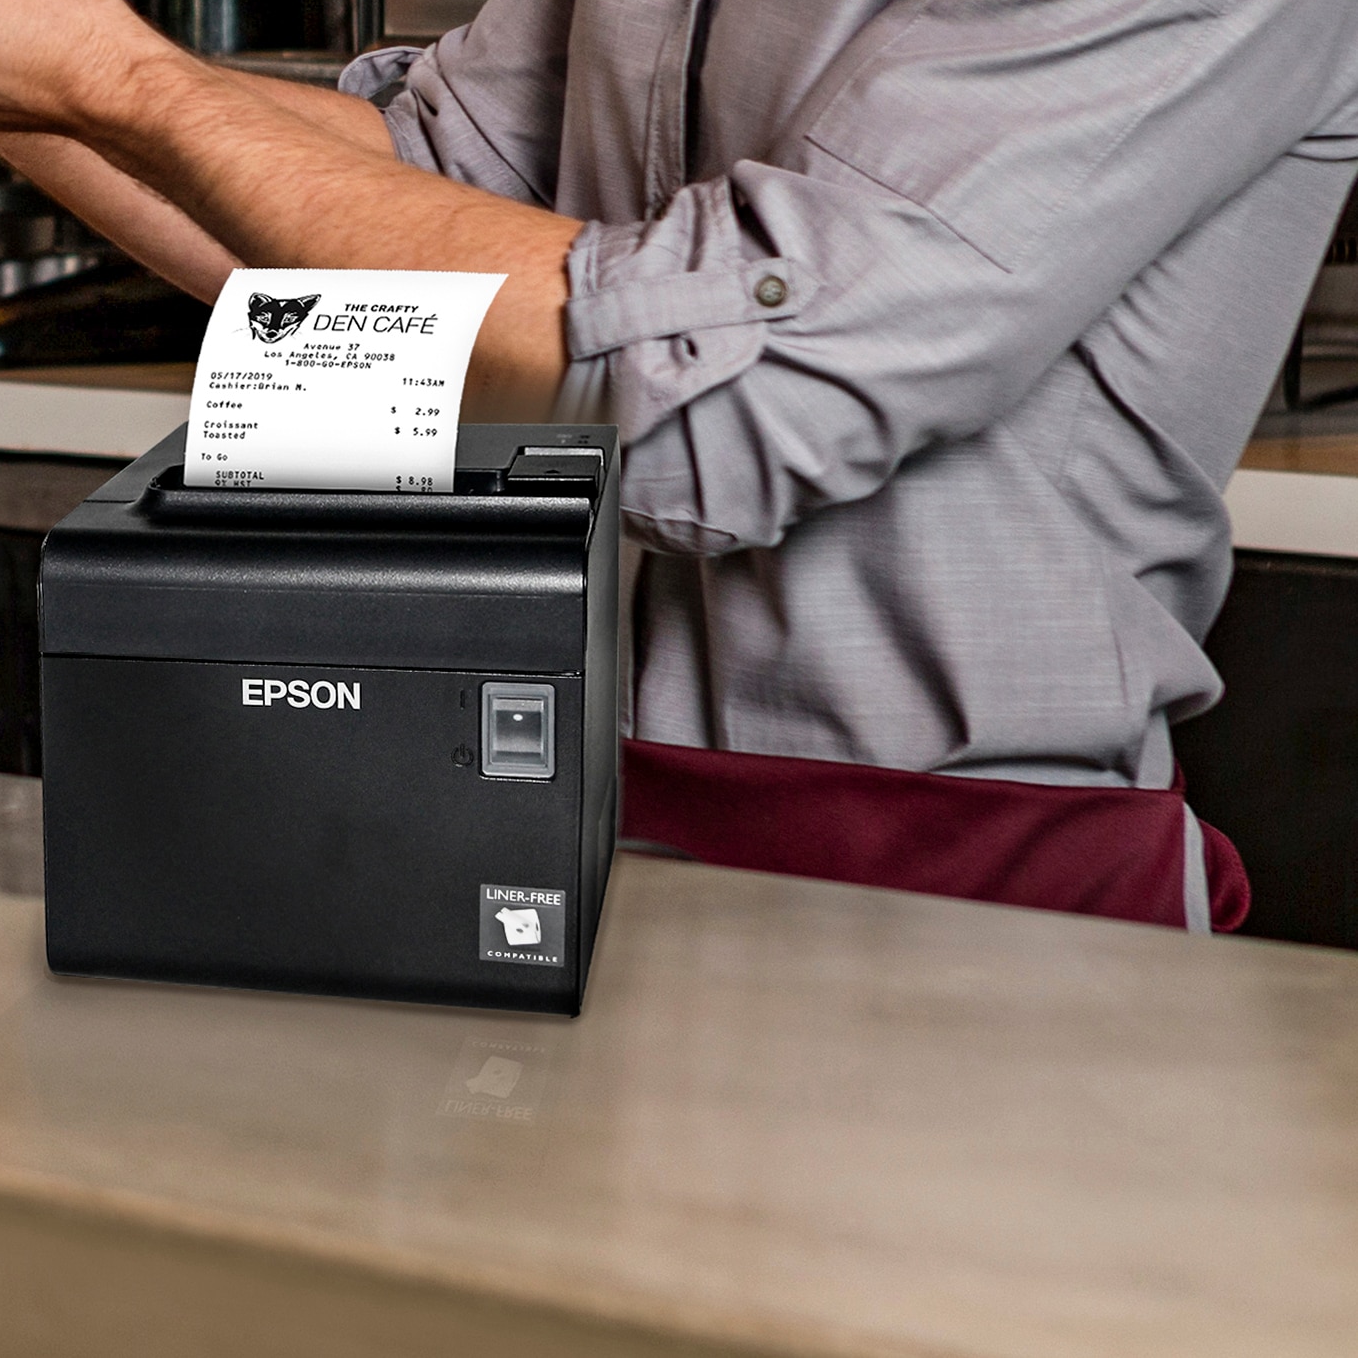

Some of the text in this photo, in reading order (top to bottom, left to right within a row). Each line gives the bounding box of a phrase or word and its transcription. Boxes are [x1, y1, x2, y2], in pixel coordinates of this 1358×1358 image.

[345, 303, 419, 313] THE CRAFTY
[313, 313, 438, 334] DEN CAFÉ
[303, 343, 360, 351] Avenue 37
[289, 351, 338, 360] Angeles,
[364, 352, 395, 361] 90038
[285, 359, 372, 369] 1-800-GO-EPSON
[210, 372, 445, 387] 05/17/2019 11:43AM
[206, 400, 440, 416] Coffee $ 2.99
[203, 430, 246, 439] Toasted
[204, 420, 438, 437] Croissant $ 5.99
[216, 453, 228, 461] Go
[216, 471, 433, 486] SUBTOTAL $ 8.98
[242, 678, 361, 710] EPSON
[486, 888, 561, 906] LINER-FREE
[487, 950, 558, 962] COMPATIBLE
